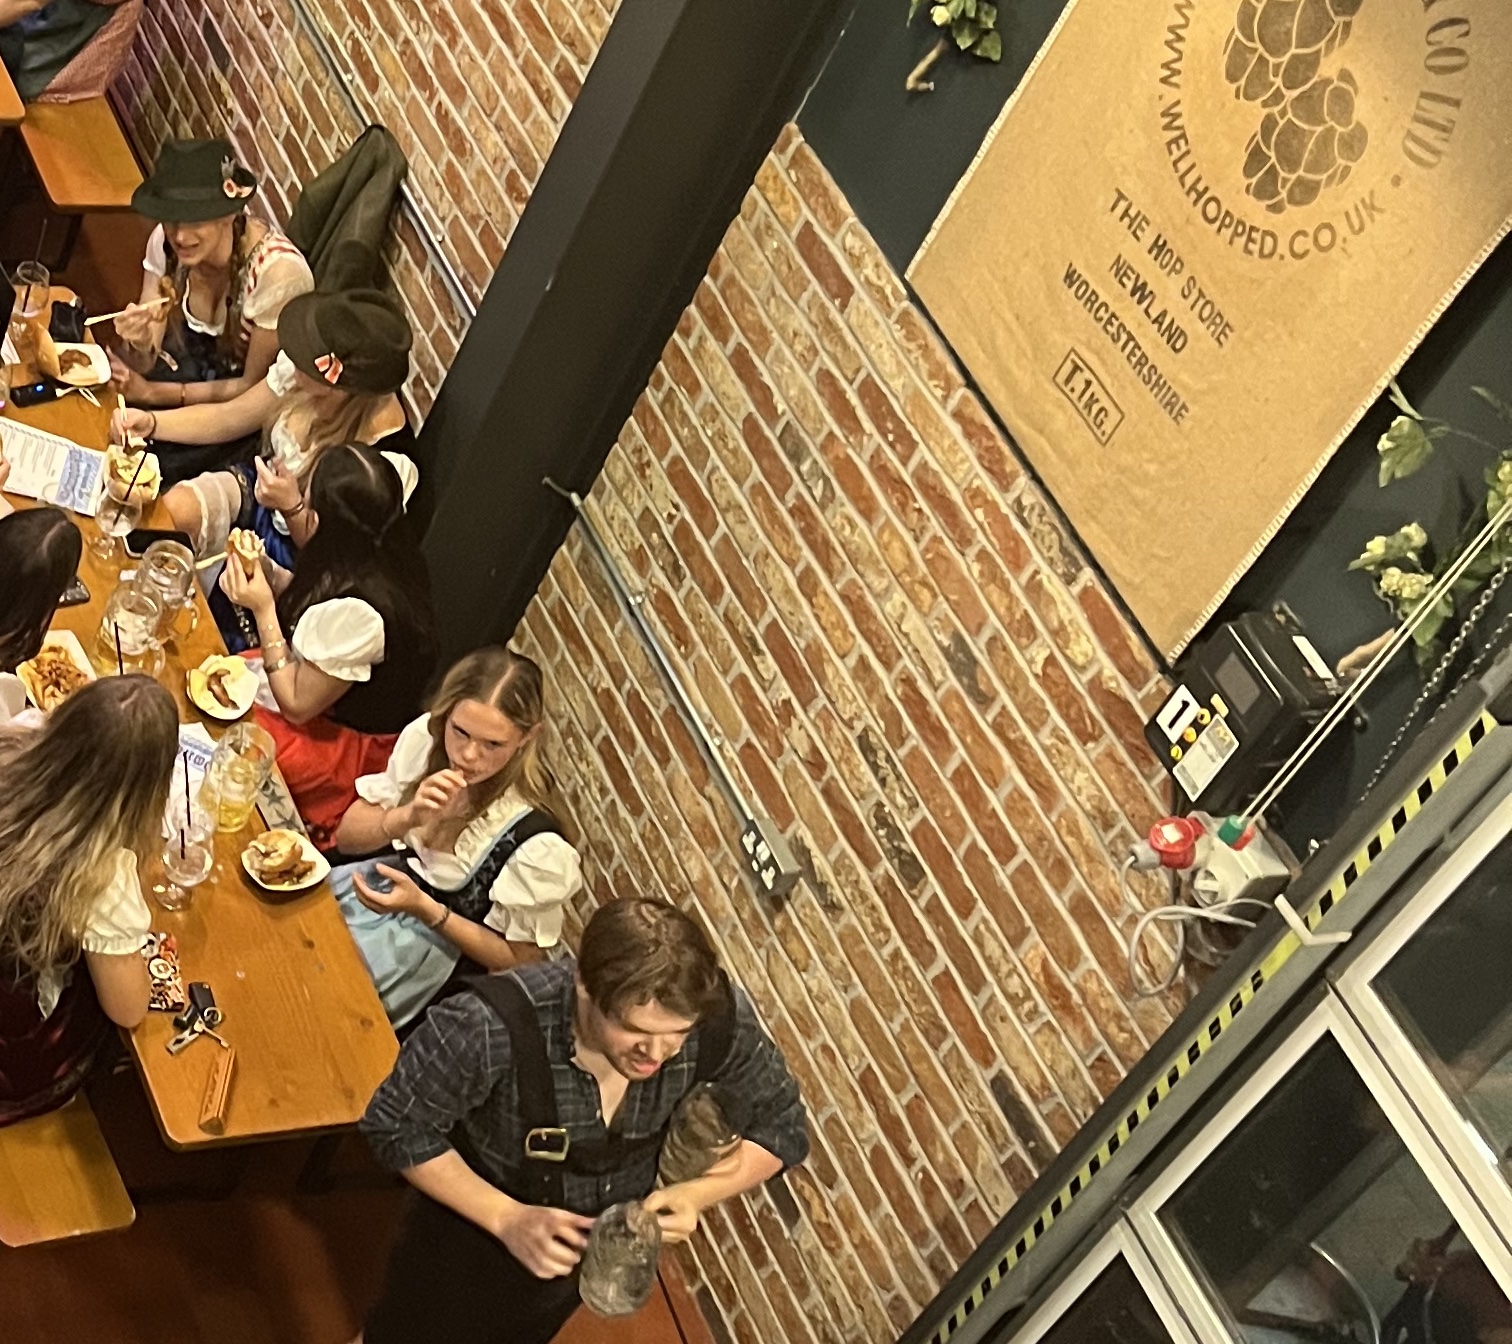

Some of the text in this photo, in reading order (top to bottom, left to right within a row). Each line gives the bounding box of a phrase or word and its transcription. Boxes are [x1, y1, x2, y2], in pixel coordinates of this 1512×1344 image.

[1423, 16, 1471, 76] CO
[1402, 90, 1463, 169] LTD
[1108, 187, 1235, 349] THE HOP STORE
[1108, 252, 1189, 355] NEWLAND
[1062, 261, 1191, 426] WORCESTERSHIRE
[1167, 699, 1191, 730] 1
